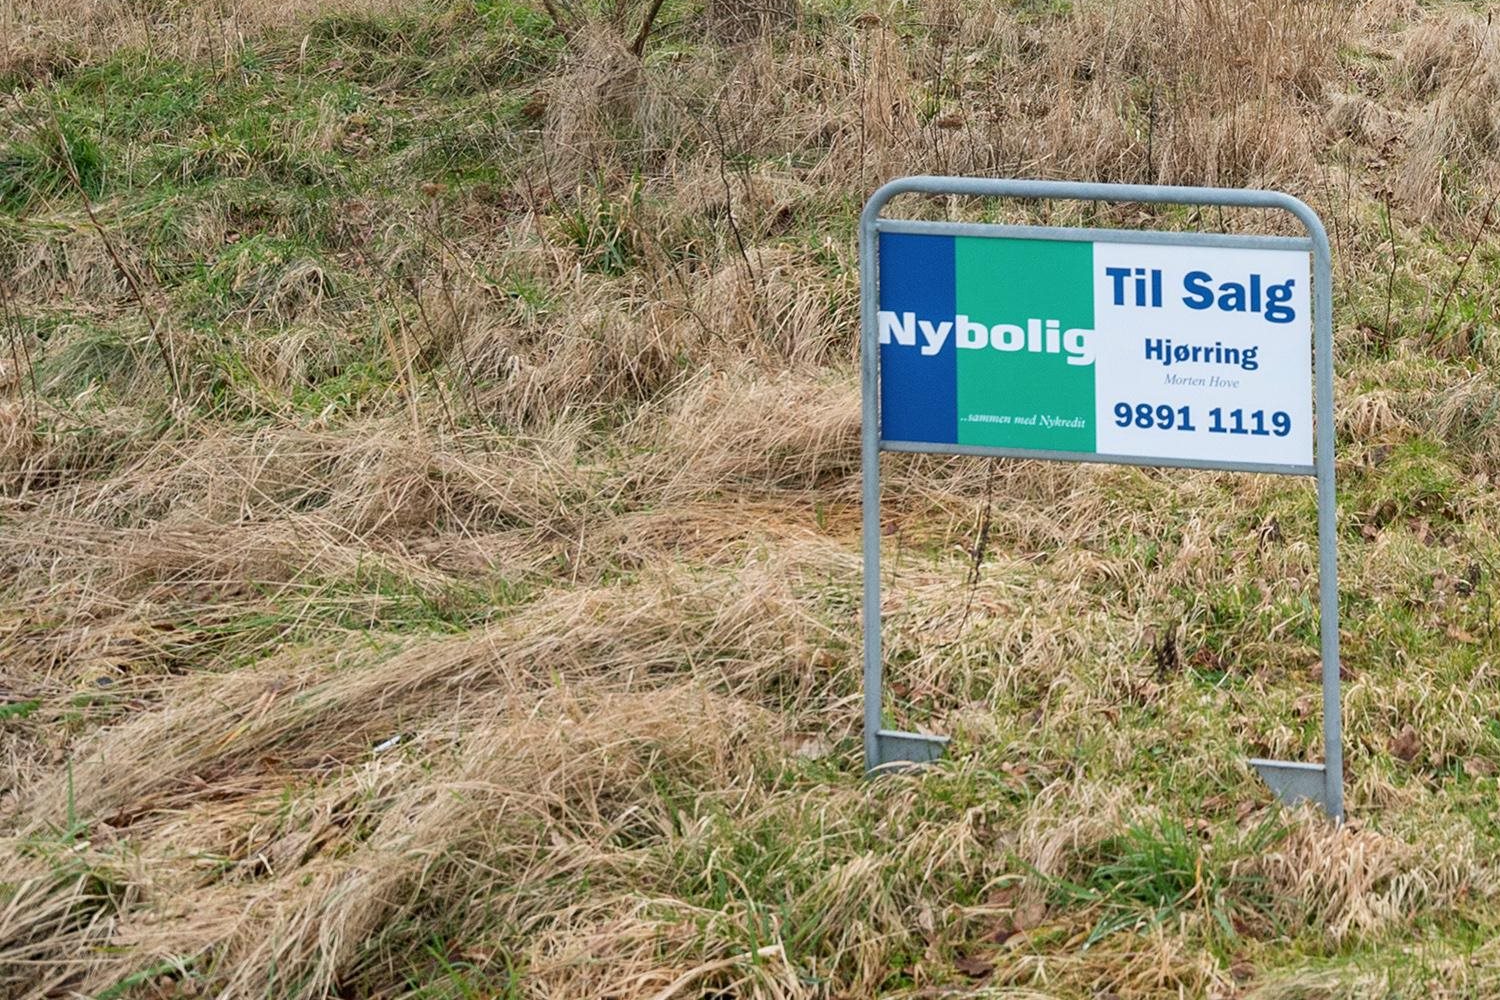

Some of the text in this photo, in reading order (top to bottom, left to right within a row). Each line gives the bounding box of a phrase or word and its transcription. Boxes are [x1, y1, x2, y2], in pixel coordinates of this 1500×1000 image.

[1105, 267, 1296, 324] Til Salg
[878, 310, 1096, 366] Nybolig
[1145, 338, 1259, 371] Hjørring
[1164, 373, 1240, 389] Morten Hove
[1014, 414, 1037, 426] med
[1039, 414, 1086, 429] Nykredit
[1114, 402, 1292, 437] 9891 1119
